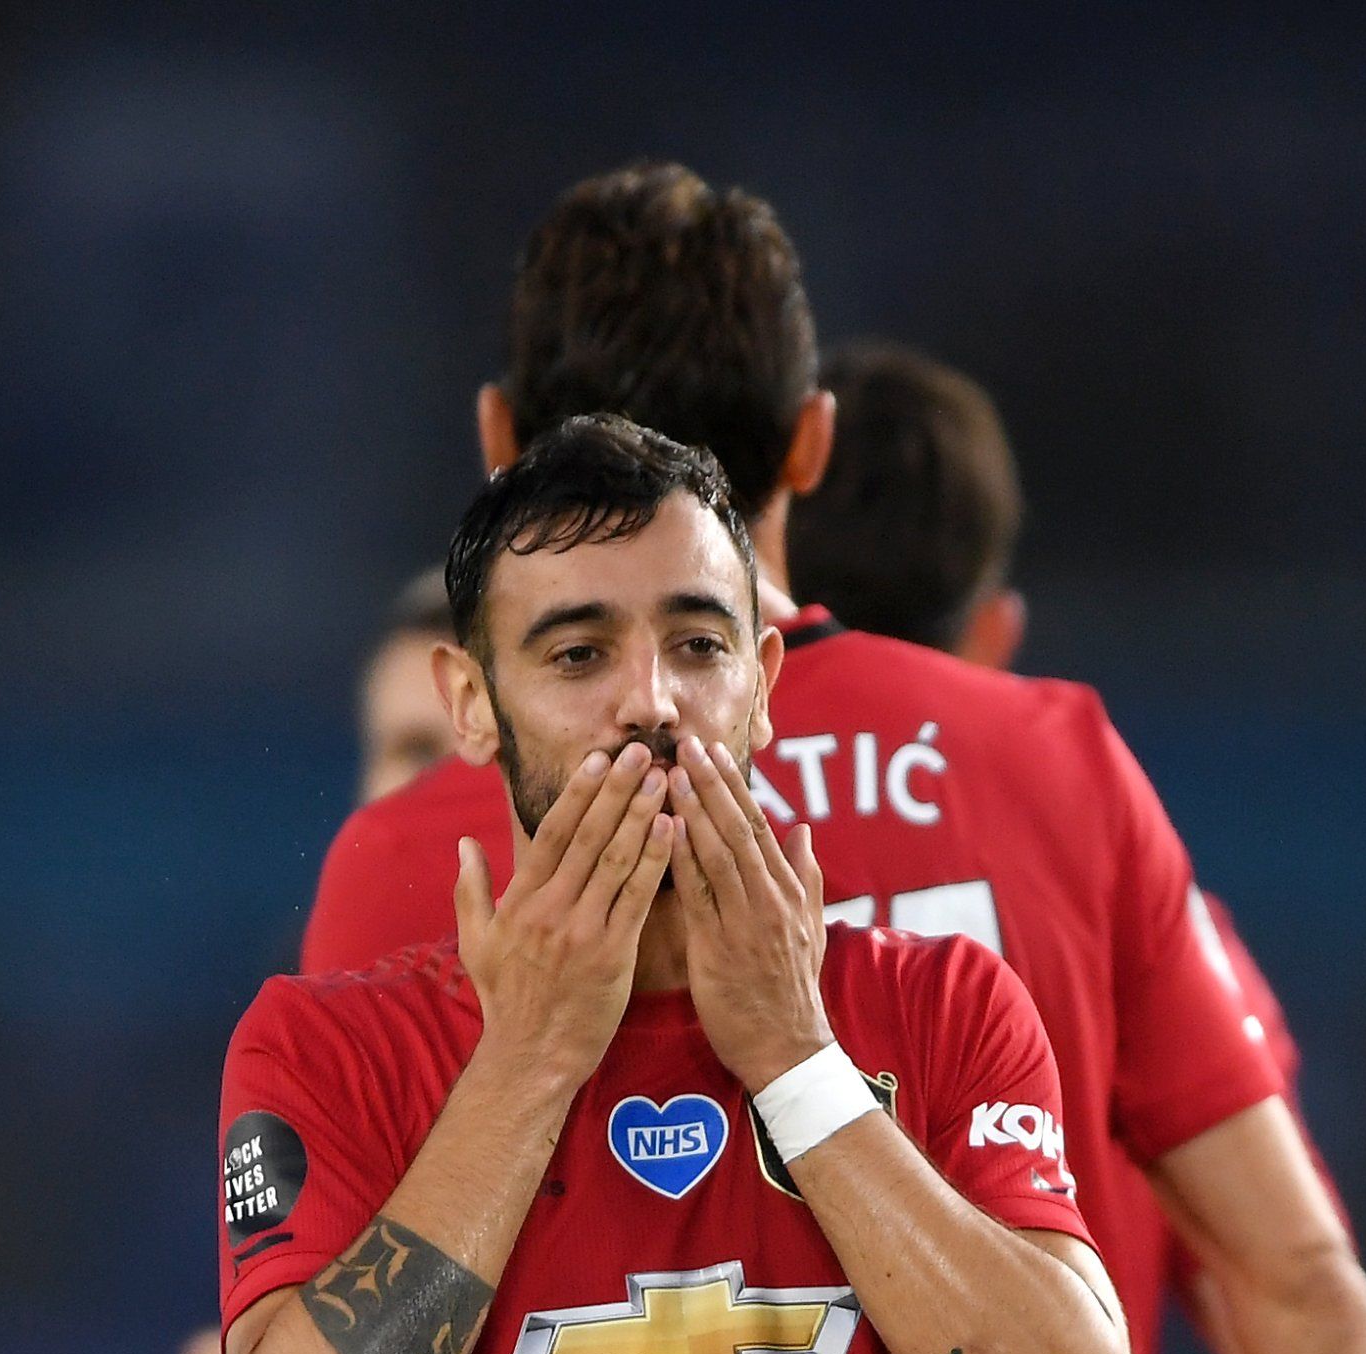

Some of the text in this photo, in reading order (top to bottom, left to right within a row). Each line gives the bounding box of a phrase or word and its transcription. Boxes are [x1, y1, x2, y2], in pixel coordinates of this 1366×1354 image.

[749, 720, 948, 826] ATIĆ
[633, 1125, 702, 1157] NHS
[224, 1164, 265, 1200] IVES
[224, 1186, 278, 1223] ATTER
